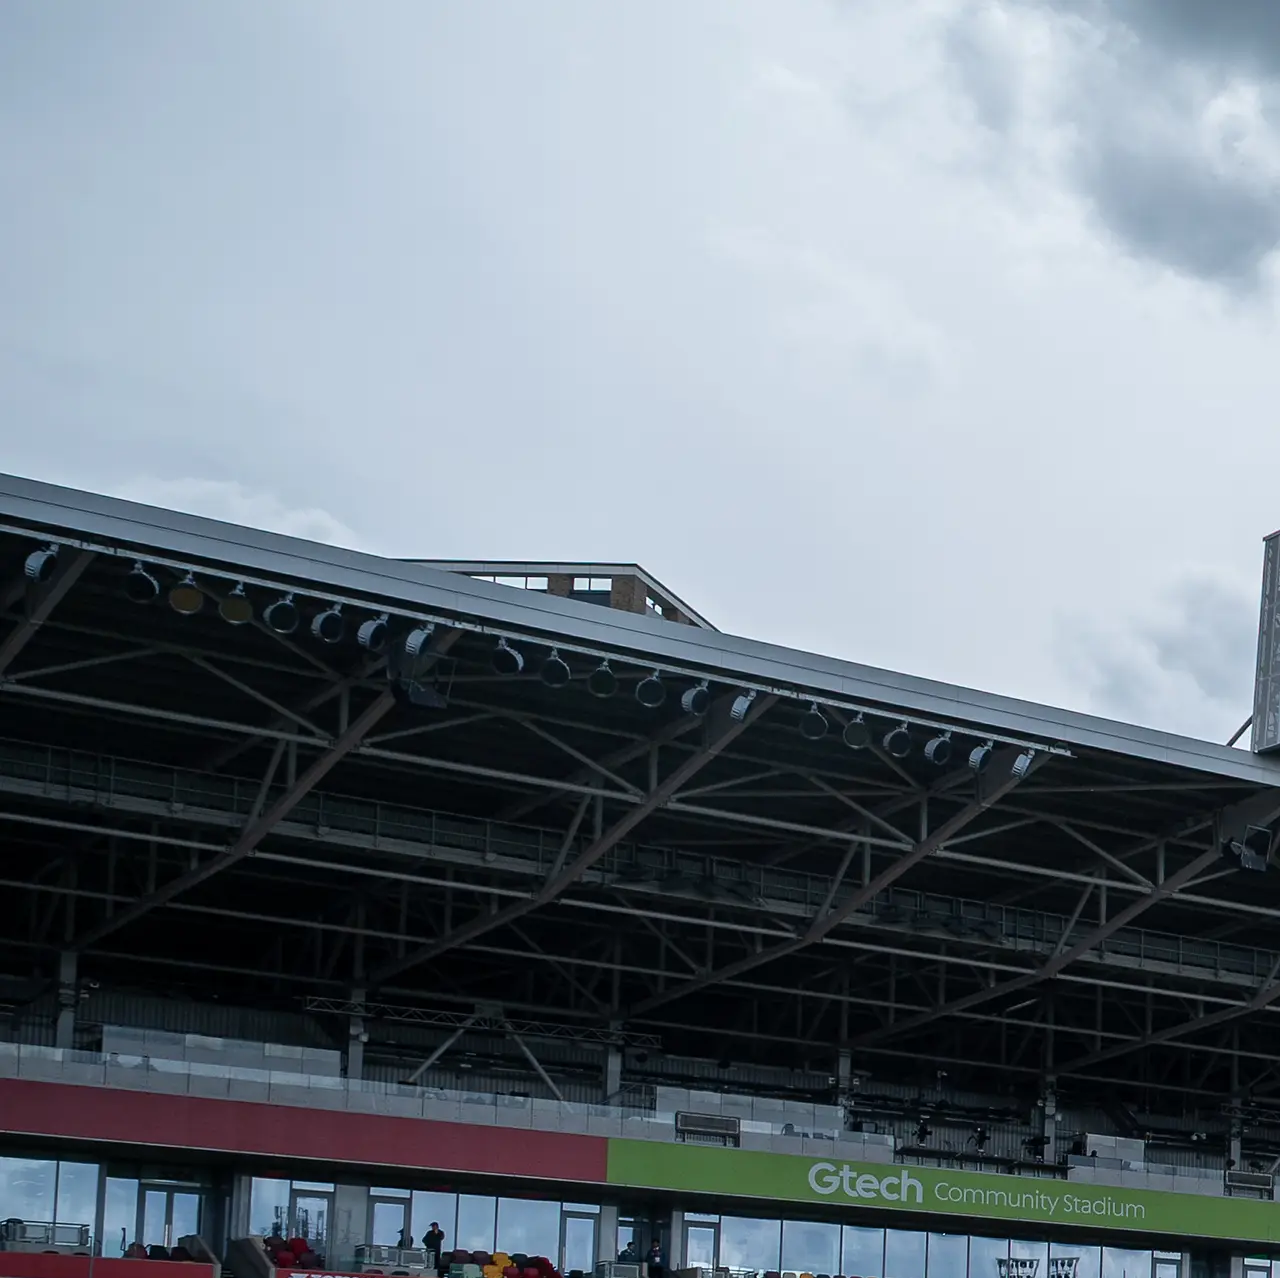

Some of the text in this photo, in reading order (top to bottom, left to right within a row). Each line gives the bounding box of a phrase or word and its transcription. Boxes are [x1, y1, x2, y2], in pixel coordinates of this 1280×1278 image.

[808, 1161, 1146, 1220] Gtech Community Stadium
